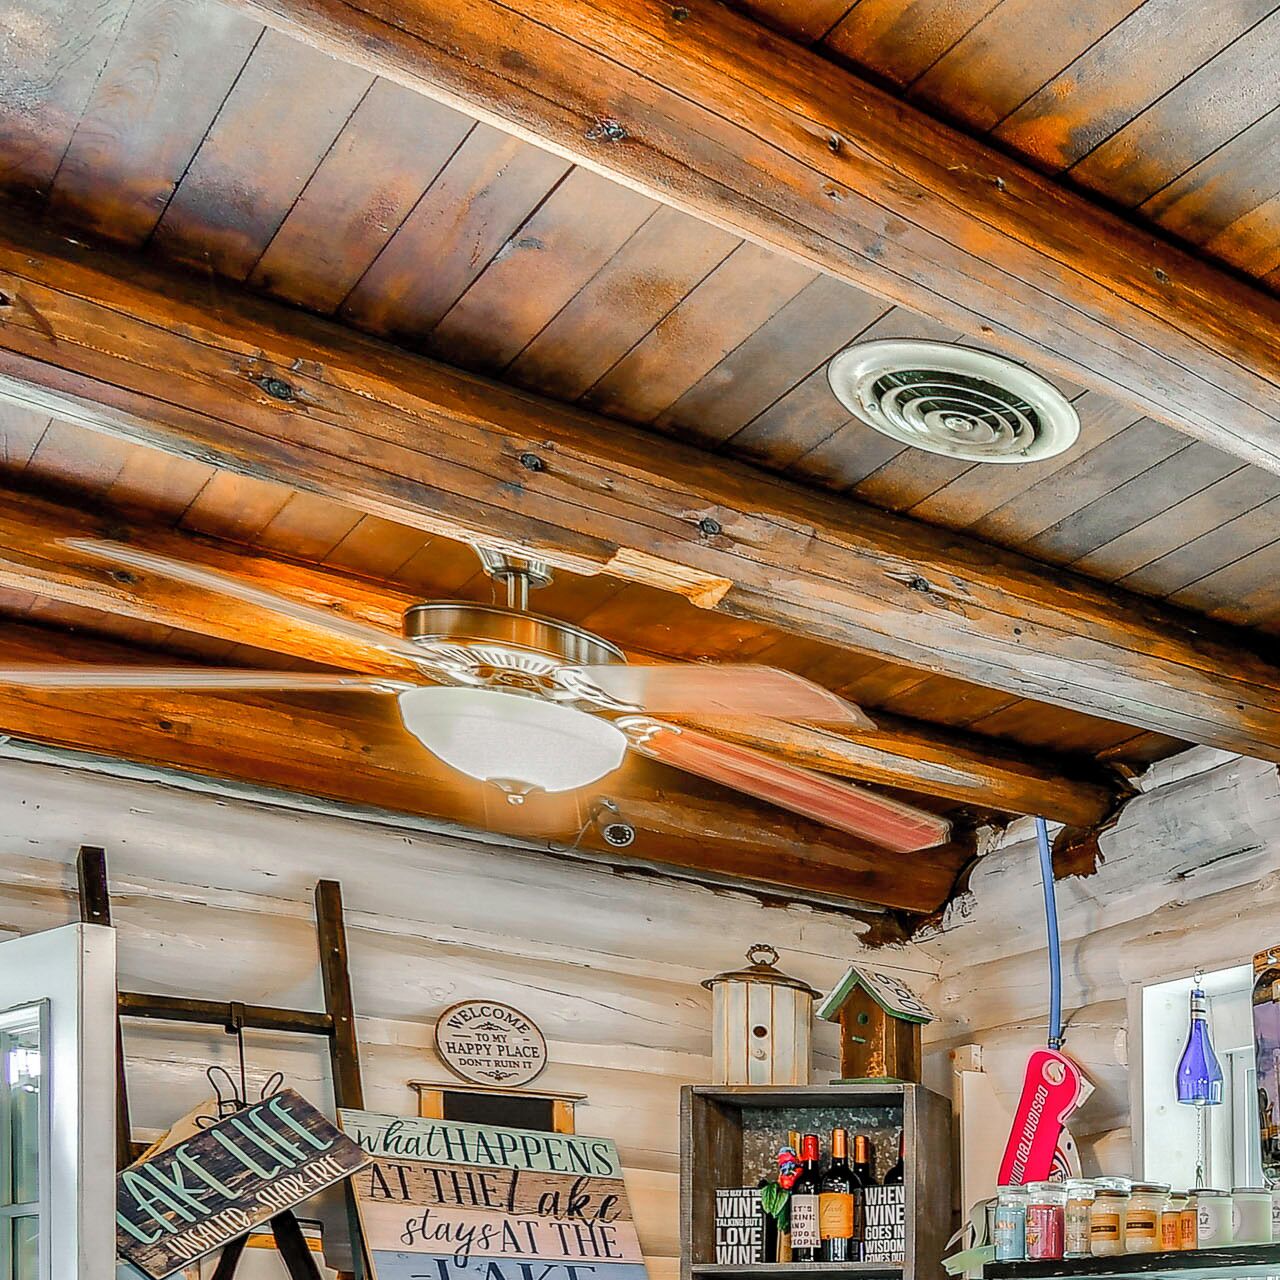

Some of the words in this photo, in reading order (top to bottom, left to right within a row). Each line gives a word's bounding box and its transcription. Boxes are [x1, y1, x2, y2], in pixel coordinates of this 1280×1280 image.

[446, 1006, 531, 1034] WELCOME
[492, 1033, 508, 1043] MY
[445, 1041, 493, 1057] HAPPY
[497, 1044, 540, 1059] PLACE
[458, 1057, 491, 1068] DON'T
[494, 1059, 520, 1069] RUIN
[357, 1120, 441, 1157] what
[440, 1126, 614, 1176] HAPPENS
[117, 1143, 243, 1244] LAKE
[212, 1096, 334, 1180] LIFE
[370, 1163, 413, 1201] AT
[423, 1168, 503, 1208] THE
[506, 1164, 623, 1225] Lake
[864, 1186, 904, 1205] WHEN
[166, 1206, 251, 1259] UNSALTED
[255, 1153, 348, 1211] SHARK-FREE
[715, 1197, 762, 1218] WINE
[864, 1205, 904, 1226] WINE
[400, 1208, 500, 1268] stays
[500, 1219, 540, 1254] AT
[549, 1222, 624, 1258] THE
[716, 1227, 762, 1245] LOVE
[865, 1226, 892, 1240] GOES
[894, 1225, 904, 1238] IN
[716, 1246, 762, 1265] WINE
[864, 1240, 905, 1253] WISDOM
